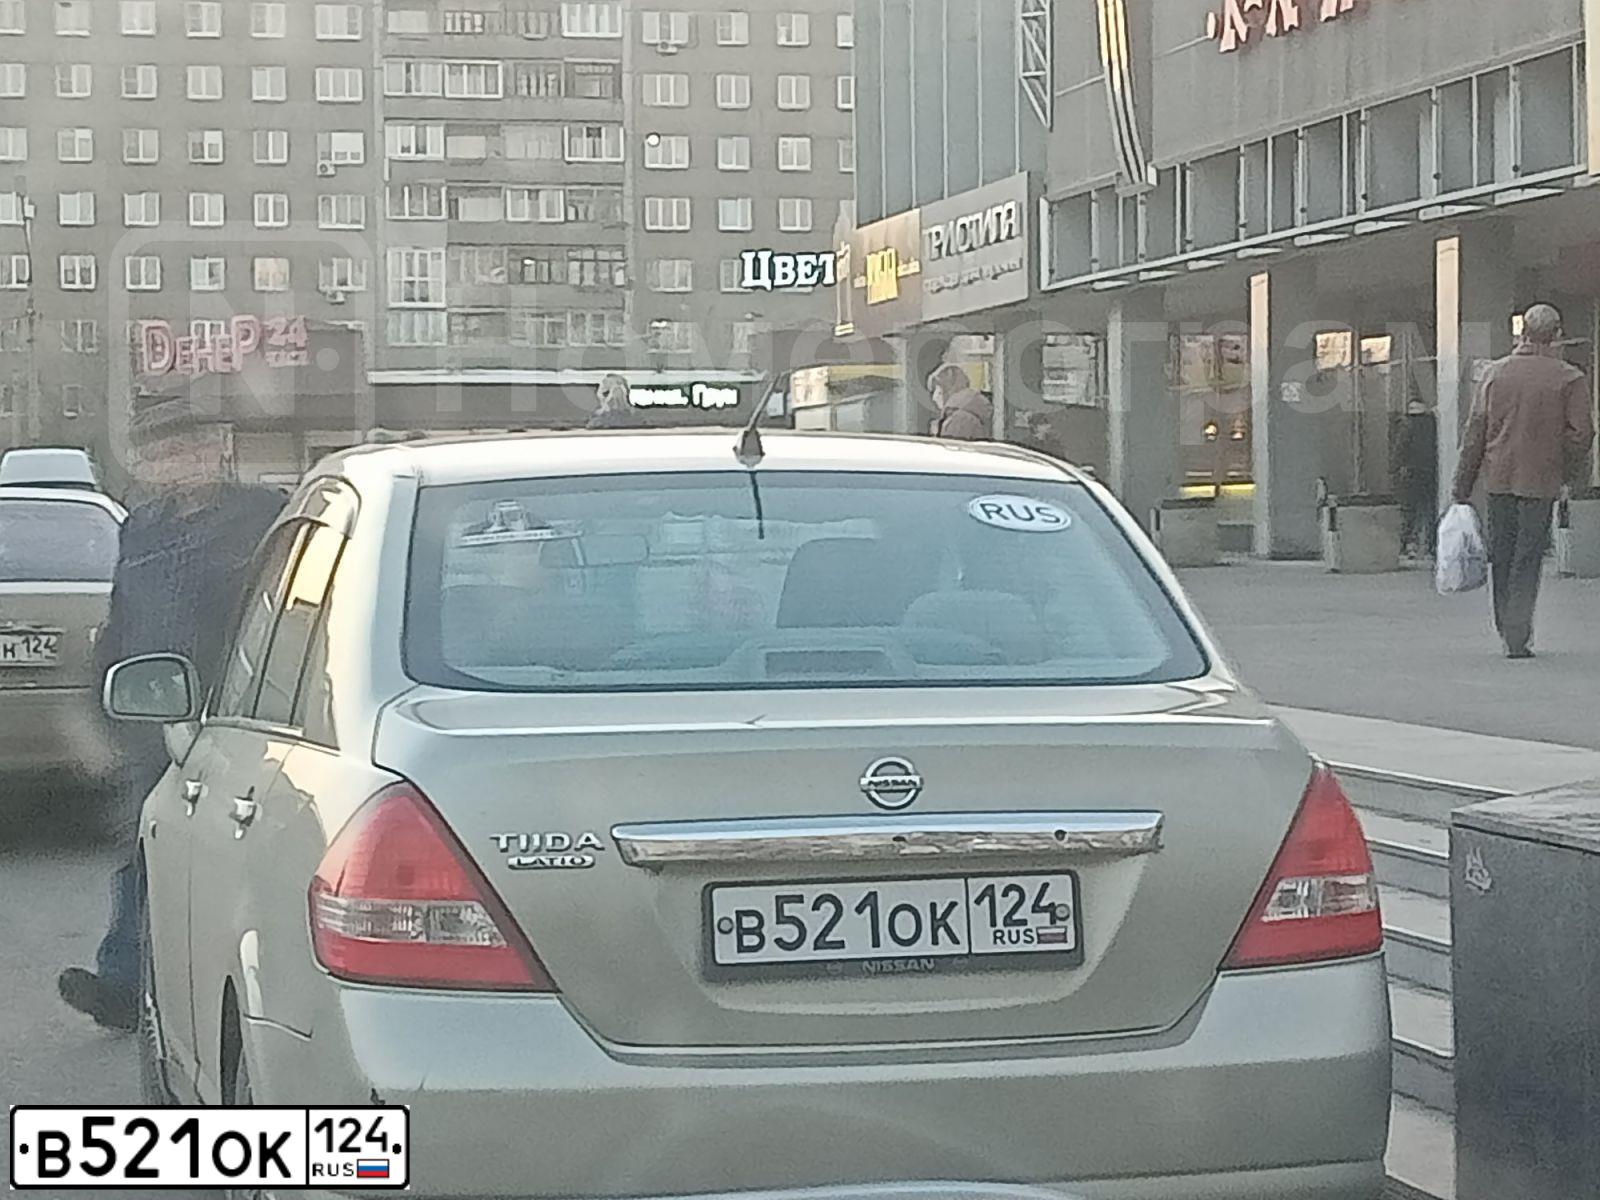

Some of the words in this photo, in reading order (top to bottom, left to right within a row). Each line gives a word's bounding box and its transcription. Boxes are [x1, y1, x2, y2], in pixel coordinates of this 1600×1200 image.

[979, 502, 1062, 524] RUS
[491, 831, 605, 853] TIIDA
[511, 855, 594, 869] LATIO
[734, 890, 961, 954] В521ОК
[974, 882, 1057, 928] 124
[992, 928, 1036, 945] RUS
[862, 959, 935, 973] NISSAN
